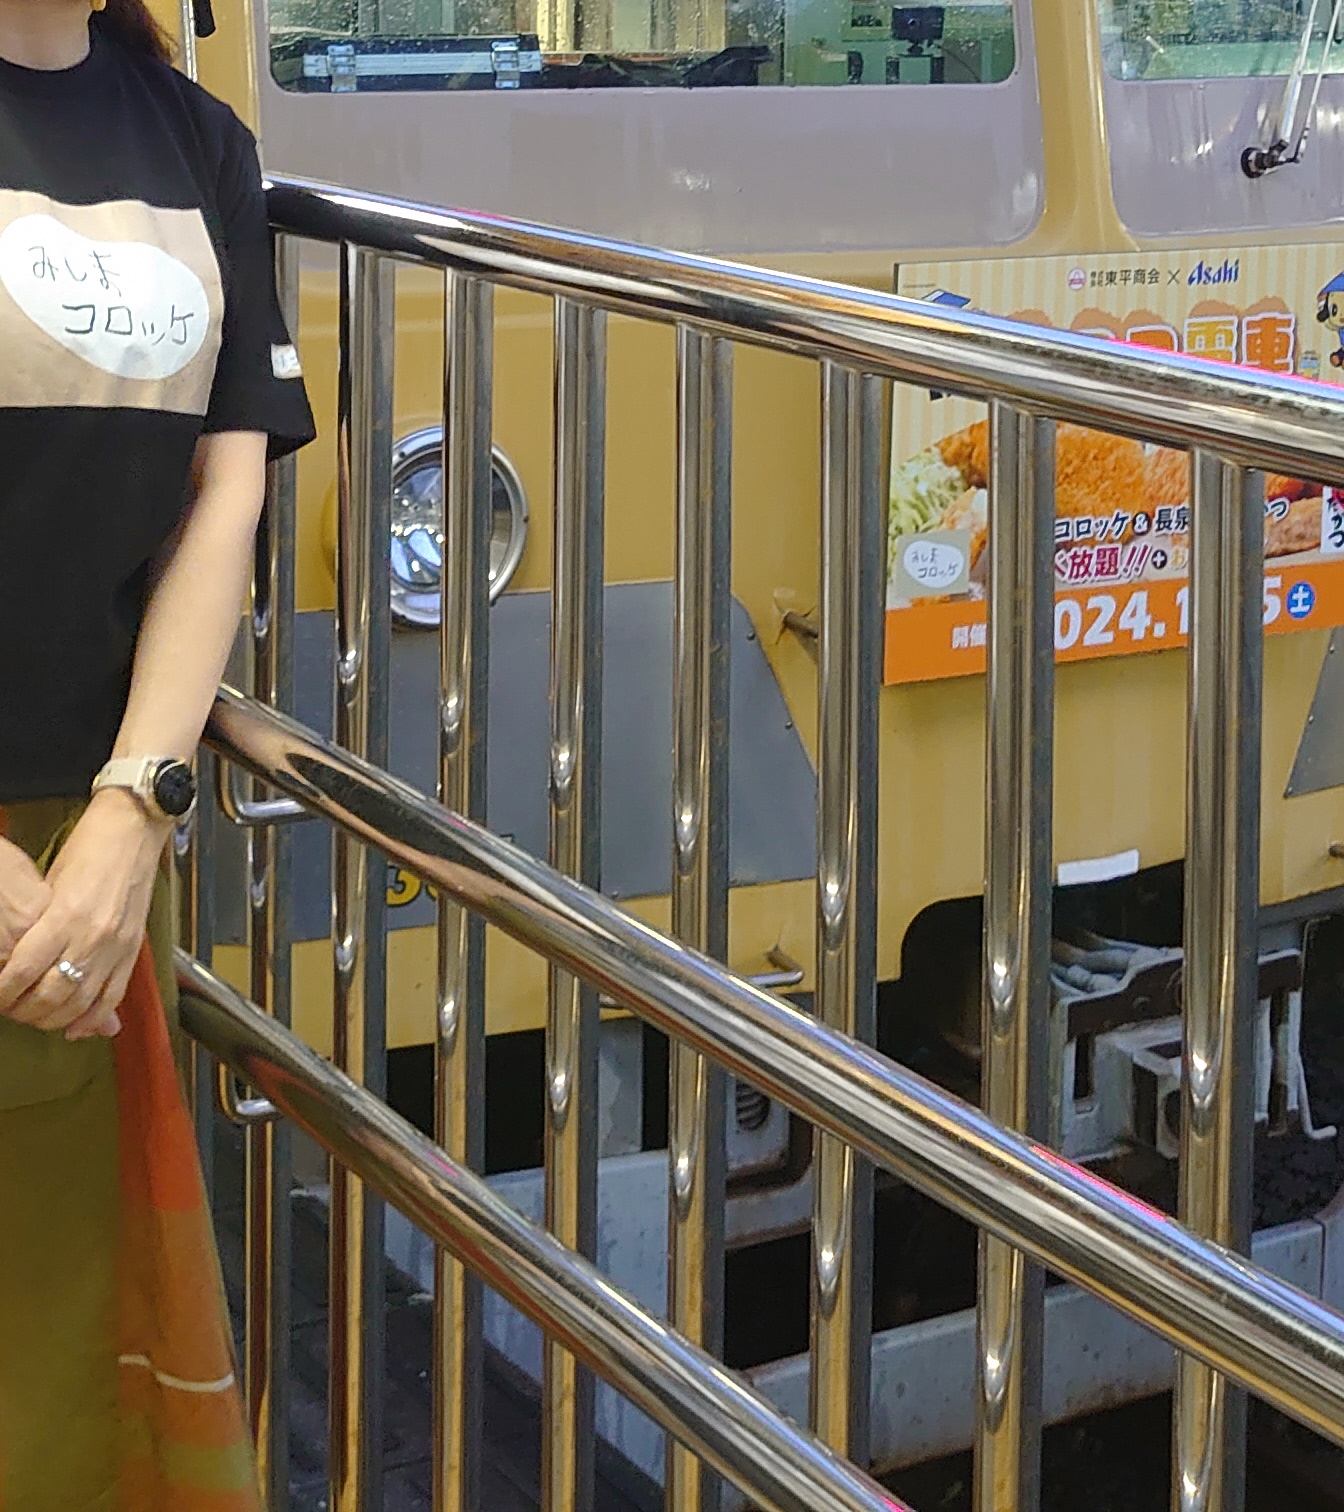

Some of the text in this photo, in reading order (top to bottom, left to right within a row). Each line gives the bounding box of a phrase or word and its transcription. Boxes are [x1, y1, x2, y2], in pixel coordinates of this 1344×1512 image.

[27, 244, 122, 297] みしま
[1187, 259, 1240, 286] Asahi
[61, 303, 195, 346] コロッケ
[917, 562, 959, 579] コロッケ
[1289, 585, 1311, 614] 土
